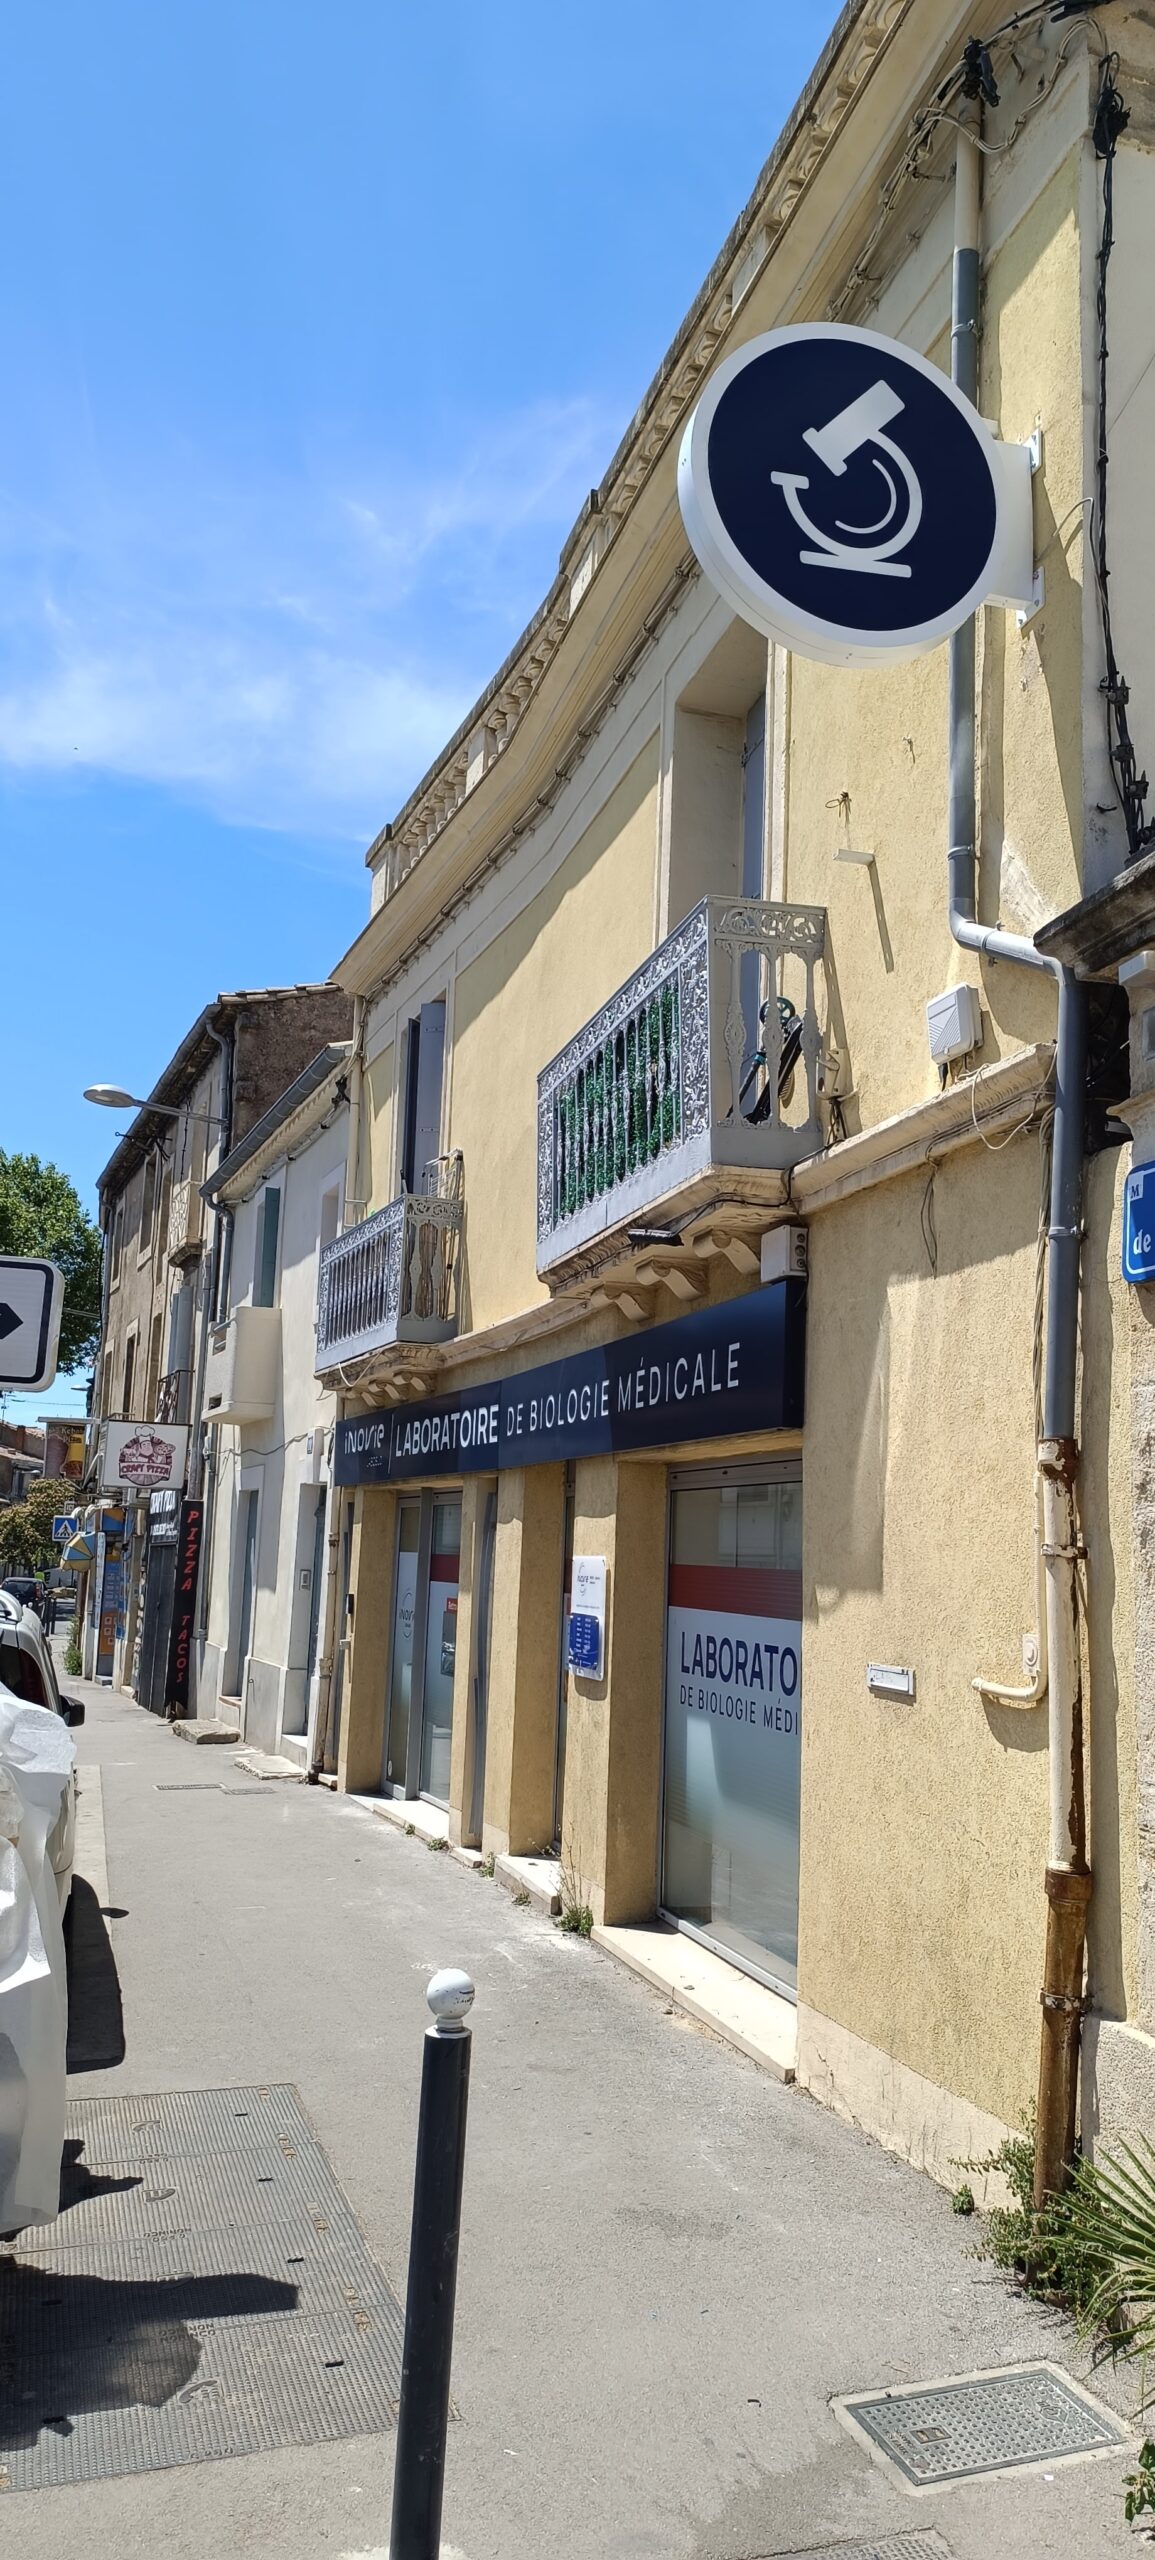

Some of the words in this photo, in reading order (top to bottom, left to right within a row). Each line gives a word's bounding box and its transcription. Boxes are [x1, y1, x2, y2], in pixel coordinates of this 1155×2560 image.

[1133, 1229, 1151, 1255] de
[395, 1404, 499, 1457] LABORATOIRE
[506, 1402, 524, 1437] DE
[529, 1379, 610, 1432] BIOLOGIE
[617, 1342, 741, 1413] MÉDICALE
[146, 1464, 169, 1476] PIZZA
[181, 1510, 199, 1590] PIZZA
[176, 1615, 191, 1683] TACOS
[681, 1631, 798, 1697] LABORATO
[680, 1684, 693, 1708] DE
[698, 1688, 757, 1724] BIOLOGIE
[763, 1697, 798, 1736] MÉDI
